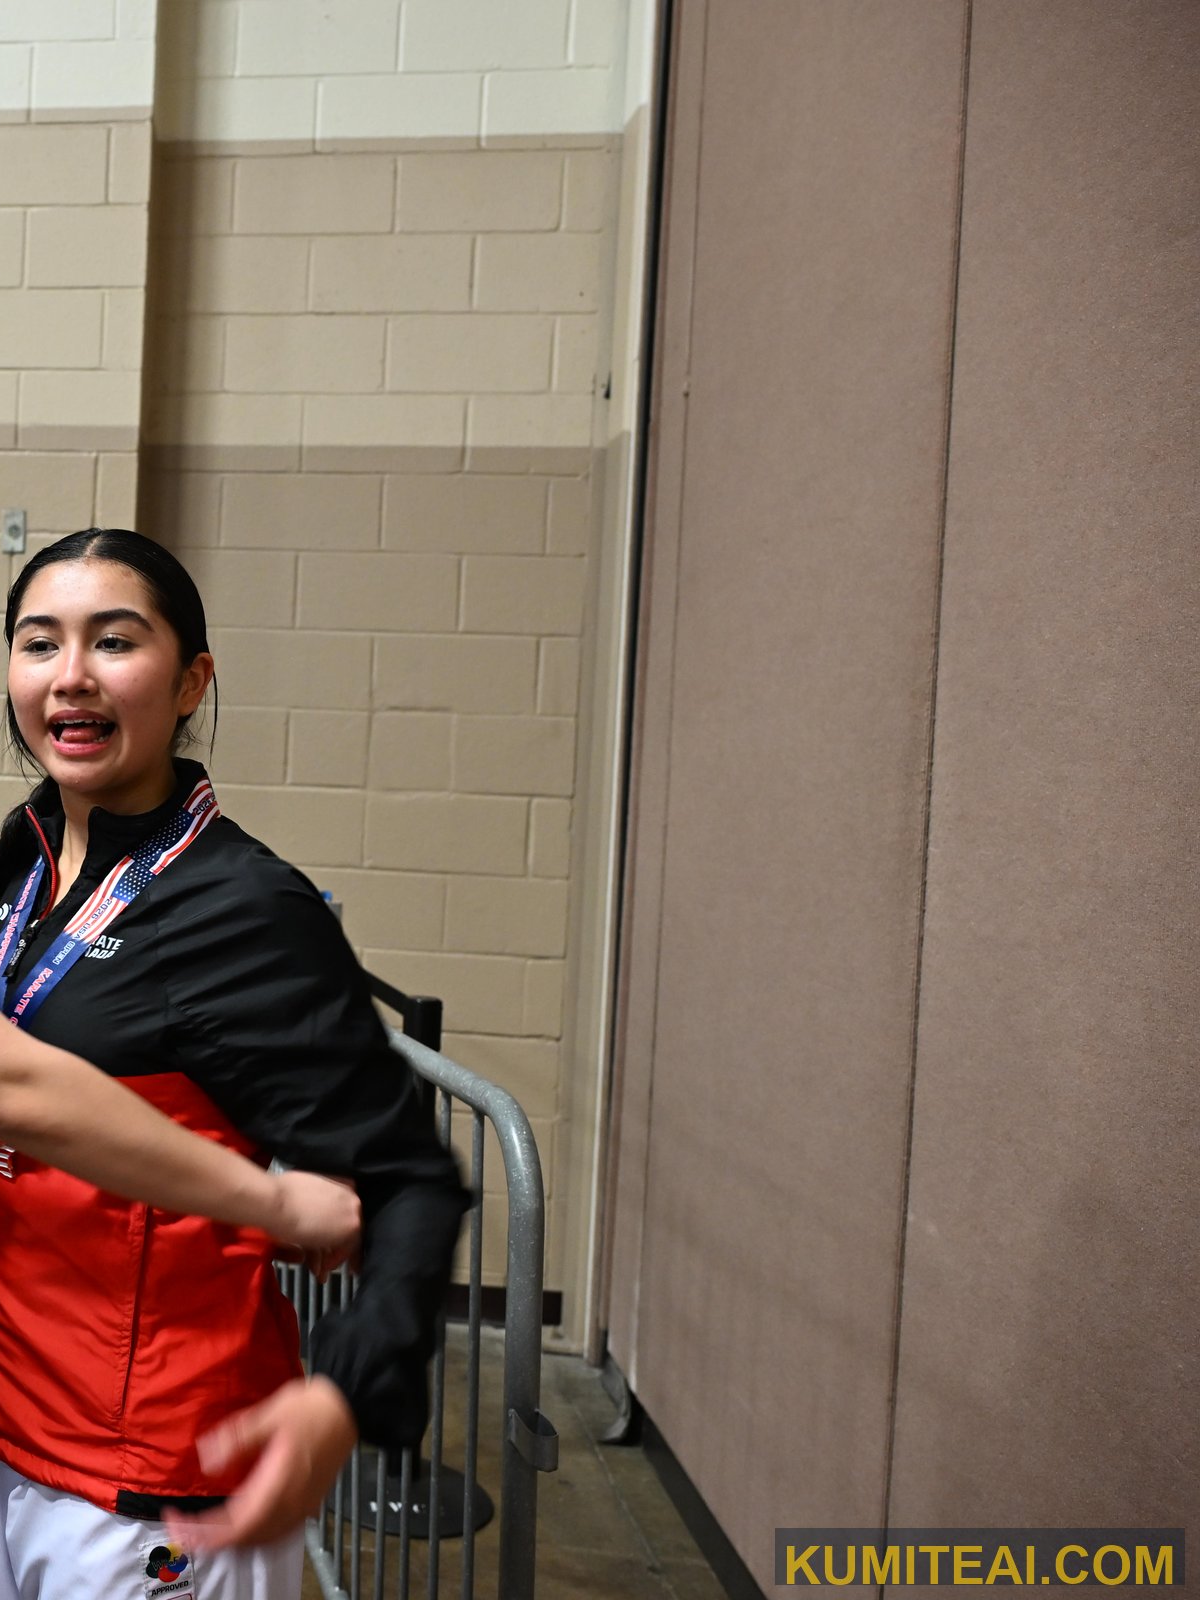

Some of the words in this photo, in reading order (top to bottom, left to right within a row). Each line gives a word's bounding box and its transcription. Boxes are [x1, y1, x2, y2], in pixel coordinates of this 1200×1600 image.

[91, 898, 113, 920] 2026
[73, 922, 91, 940] USA
[92, 934, 124, 951] ATE
[13, 967, 54, 1016] KARATE
[151, 1580, 189, 1597] APPROVED
